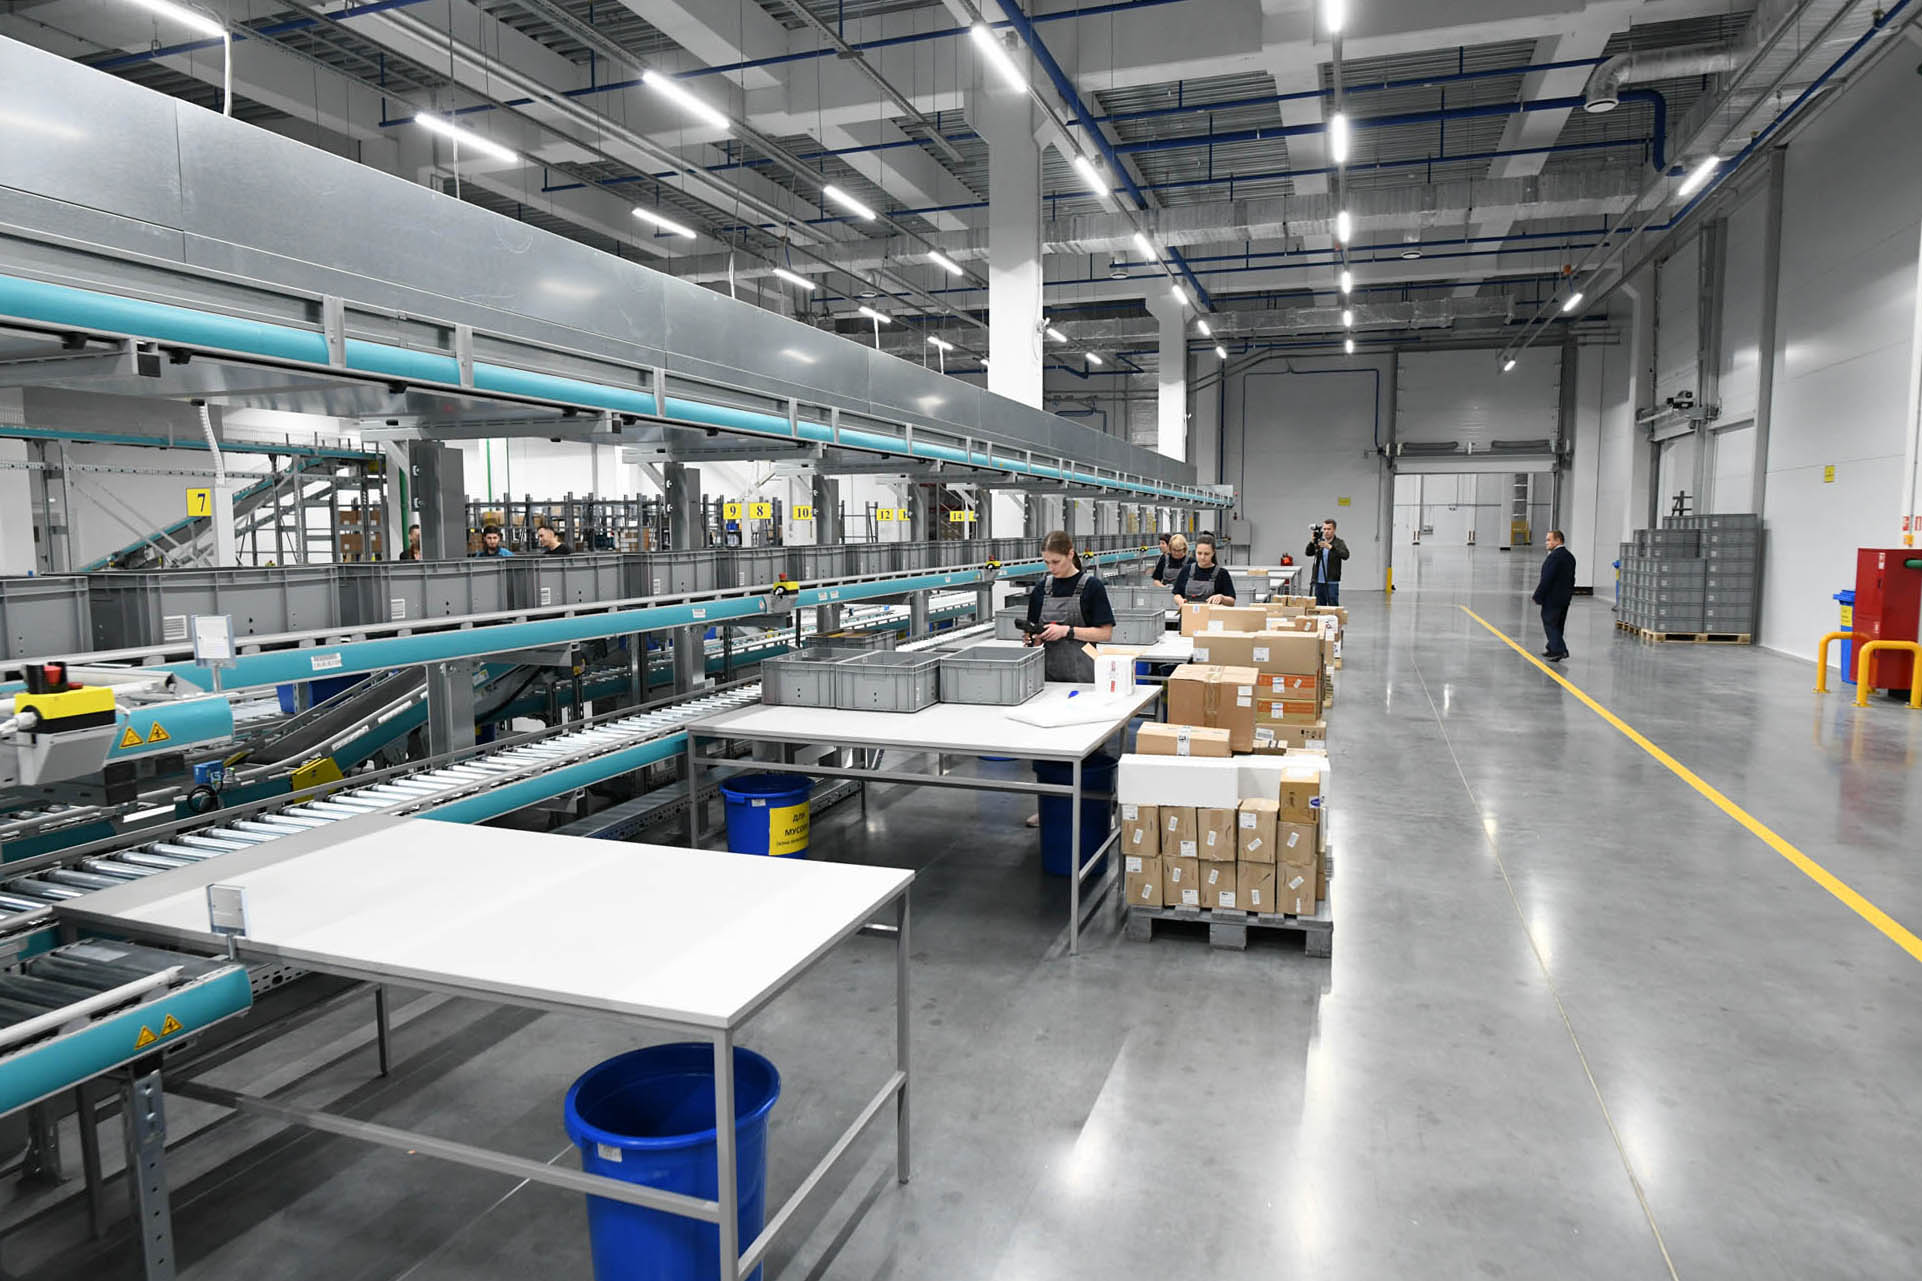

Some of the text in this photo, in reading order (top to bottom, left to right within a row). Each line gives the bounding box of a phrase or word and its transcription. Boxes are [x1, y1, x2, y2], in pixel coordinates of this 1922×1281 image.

[197, 493, 206, 512] 7
[730, 505, 737, 516] 9
[756, 505, 764, 517] 8
[797, 508, 809, 518] 10
[881, 510, 890, 519] 12
[953, 512, 962, 520] 14
